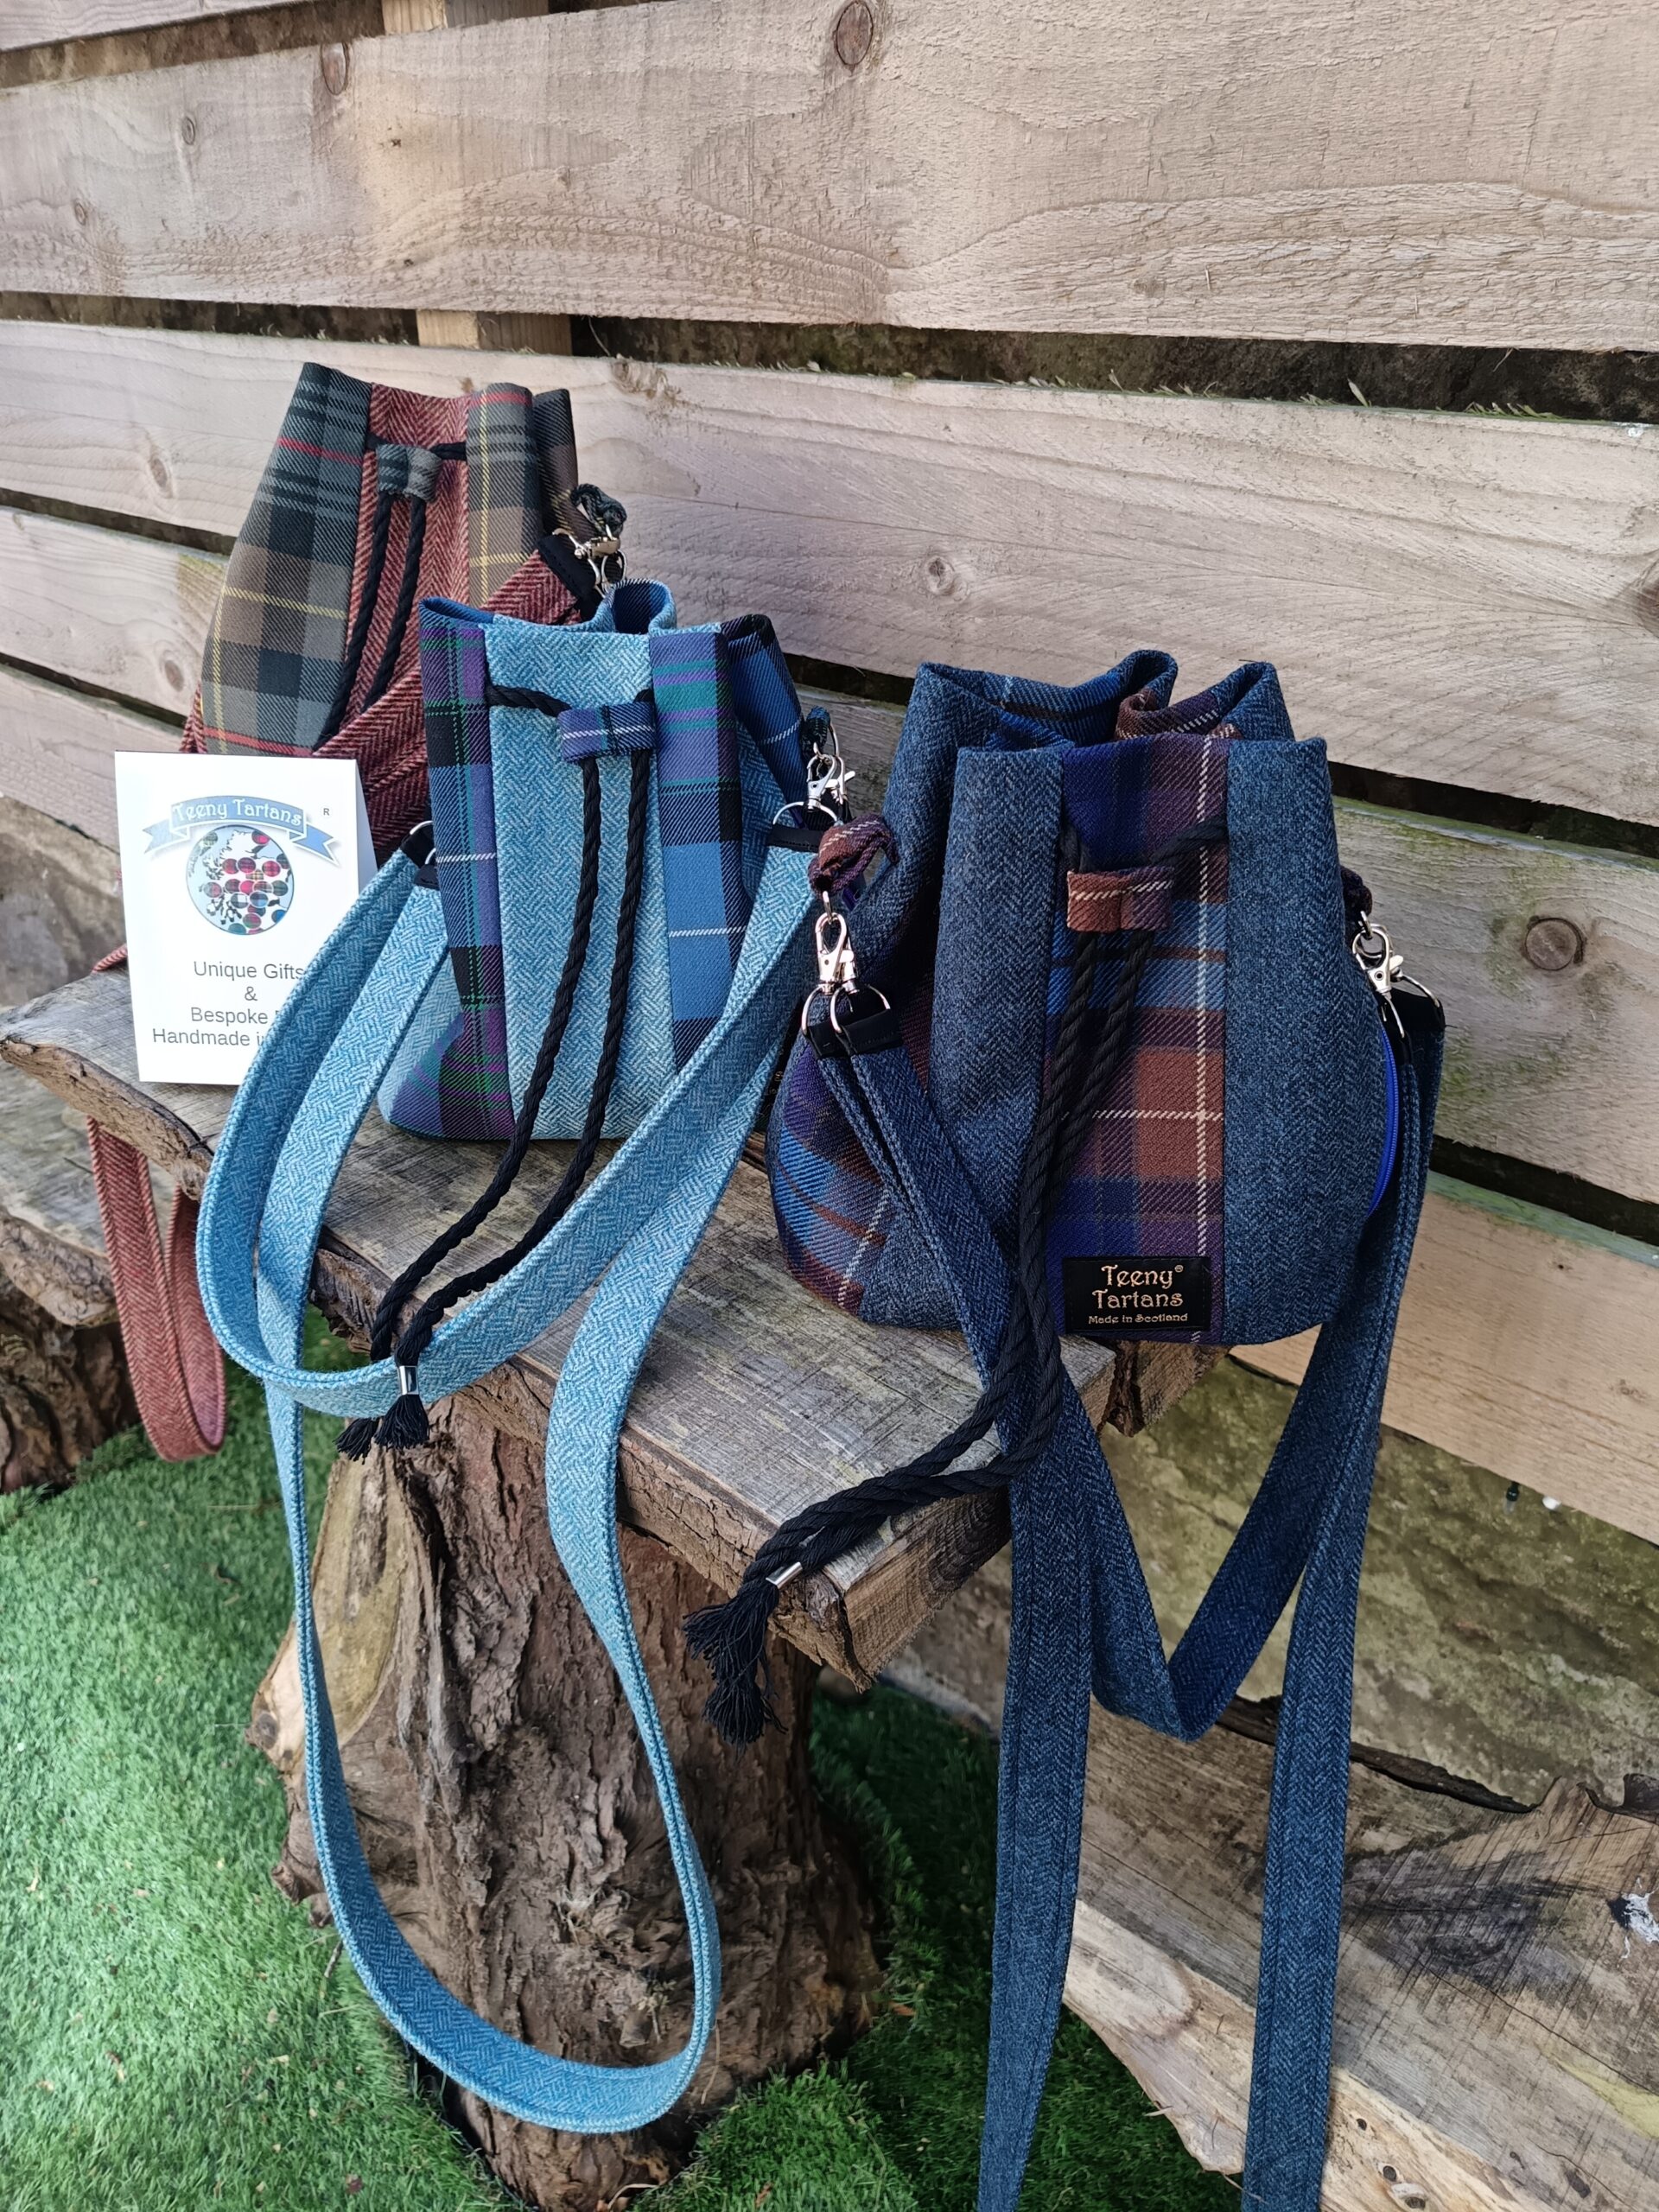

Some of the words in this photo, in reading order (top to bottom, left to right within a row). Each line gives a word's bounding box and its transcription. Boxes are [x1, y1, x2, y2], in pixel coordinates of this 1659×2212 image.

[172, 799, 227, 822] Teeny
[232, 798, 303, 827] Tartans
[194, 961, 257, 981] Unique
[263, 963, 304, 980] Gifts
[244, 986, 257, 1001] &
[191, 1007, 269, 1027] Bespoke
[152, 1029, 251, 1046] Handmade
[1092, 1288, 1184, 1309] Tartans
[1088, 1315, 1119, 1325] Made
[1122, 1314, 1133, 1323] in
[1135, 1313, 1188, 1323] Scotland
